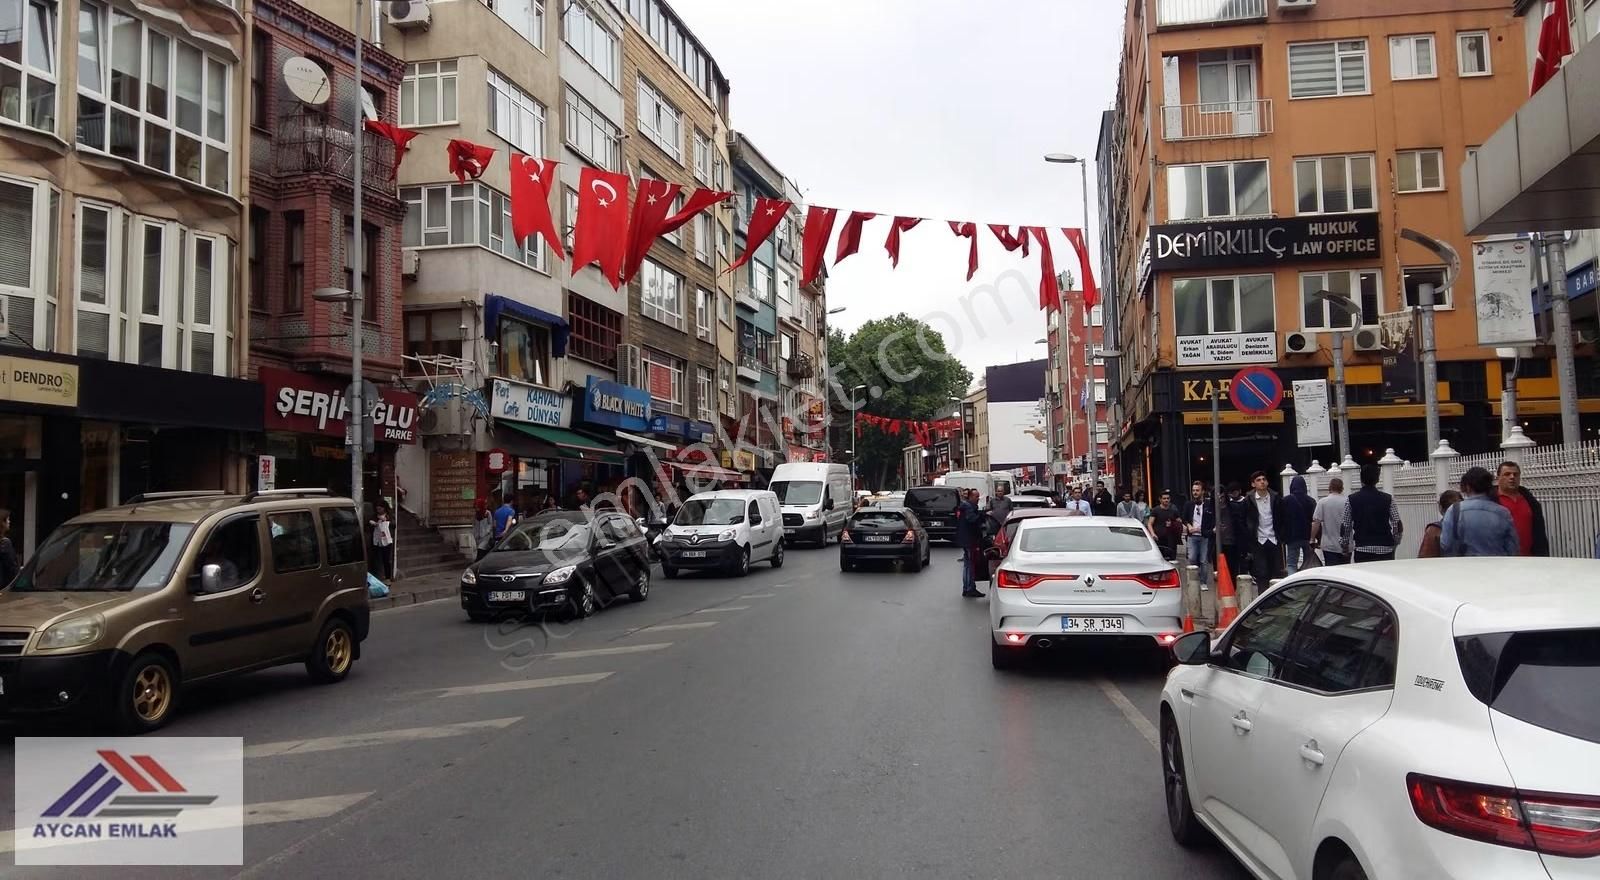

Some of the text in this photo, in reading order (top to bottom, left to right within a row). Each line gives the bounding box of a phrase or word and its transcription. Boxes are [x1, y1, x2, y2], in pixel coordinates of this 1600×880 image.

[1308, 220, 1358, 236] HUKUK
[1157, 225, 1287, 258] DEMİRKILIÇ
[1293, 238, 1375, 255] LAW OFFICE
[14, 370, 63, 387] DENDRO
[527, 388, 564, 409] KAHVALTI
[601, 394, 644, 418] BLACK WHITE
[503, 400, 520, 418] Cafe
[527, 406, 561, 426] DÜNYASI
[385, 428, 413, 441] PARKE
[1068, 619, 1122, 629] 34 SR 1349
